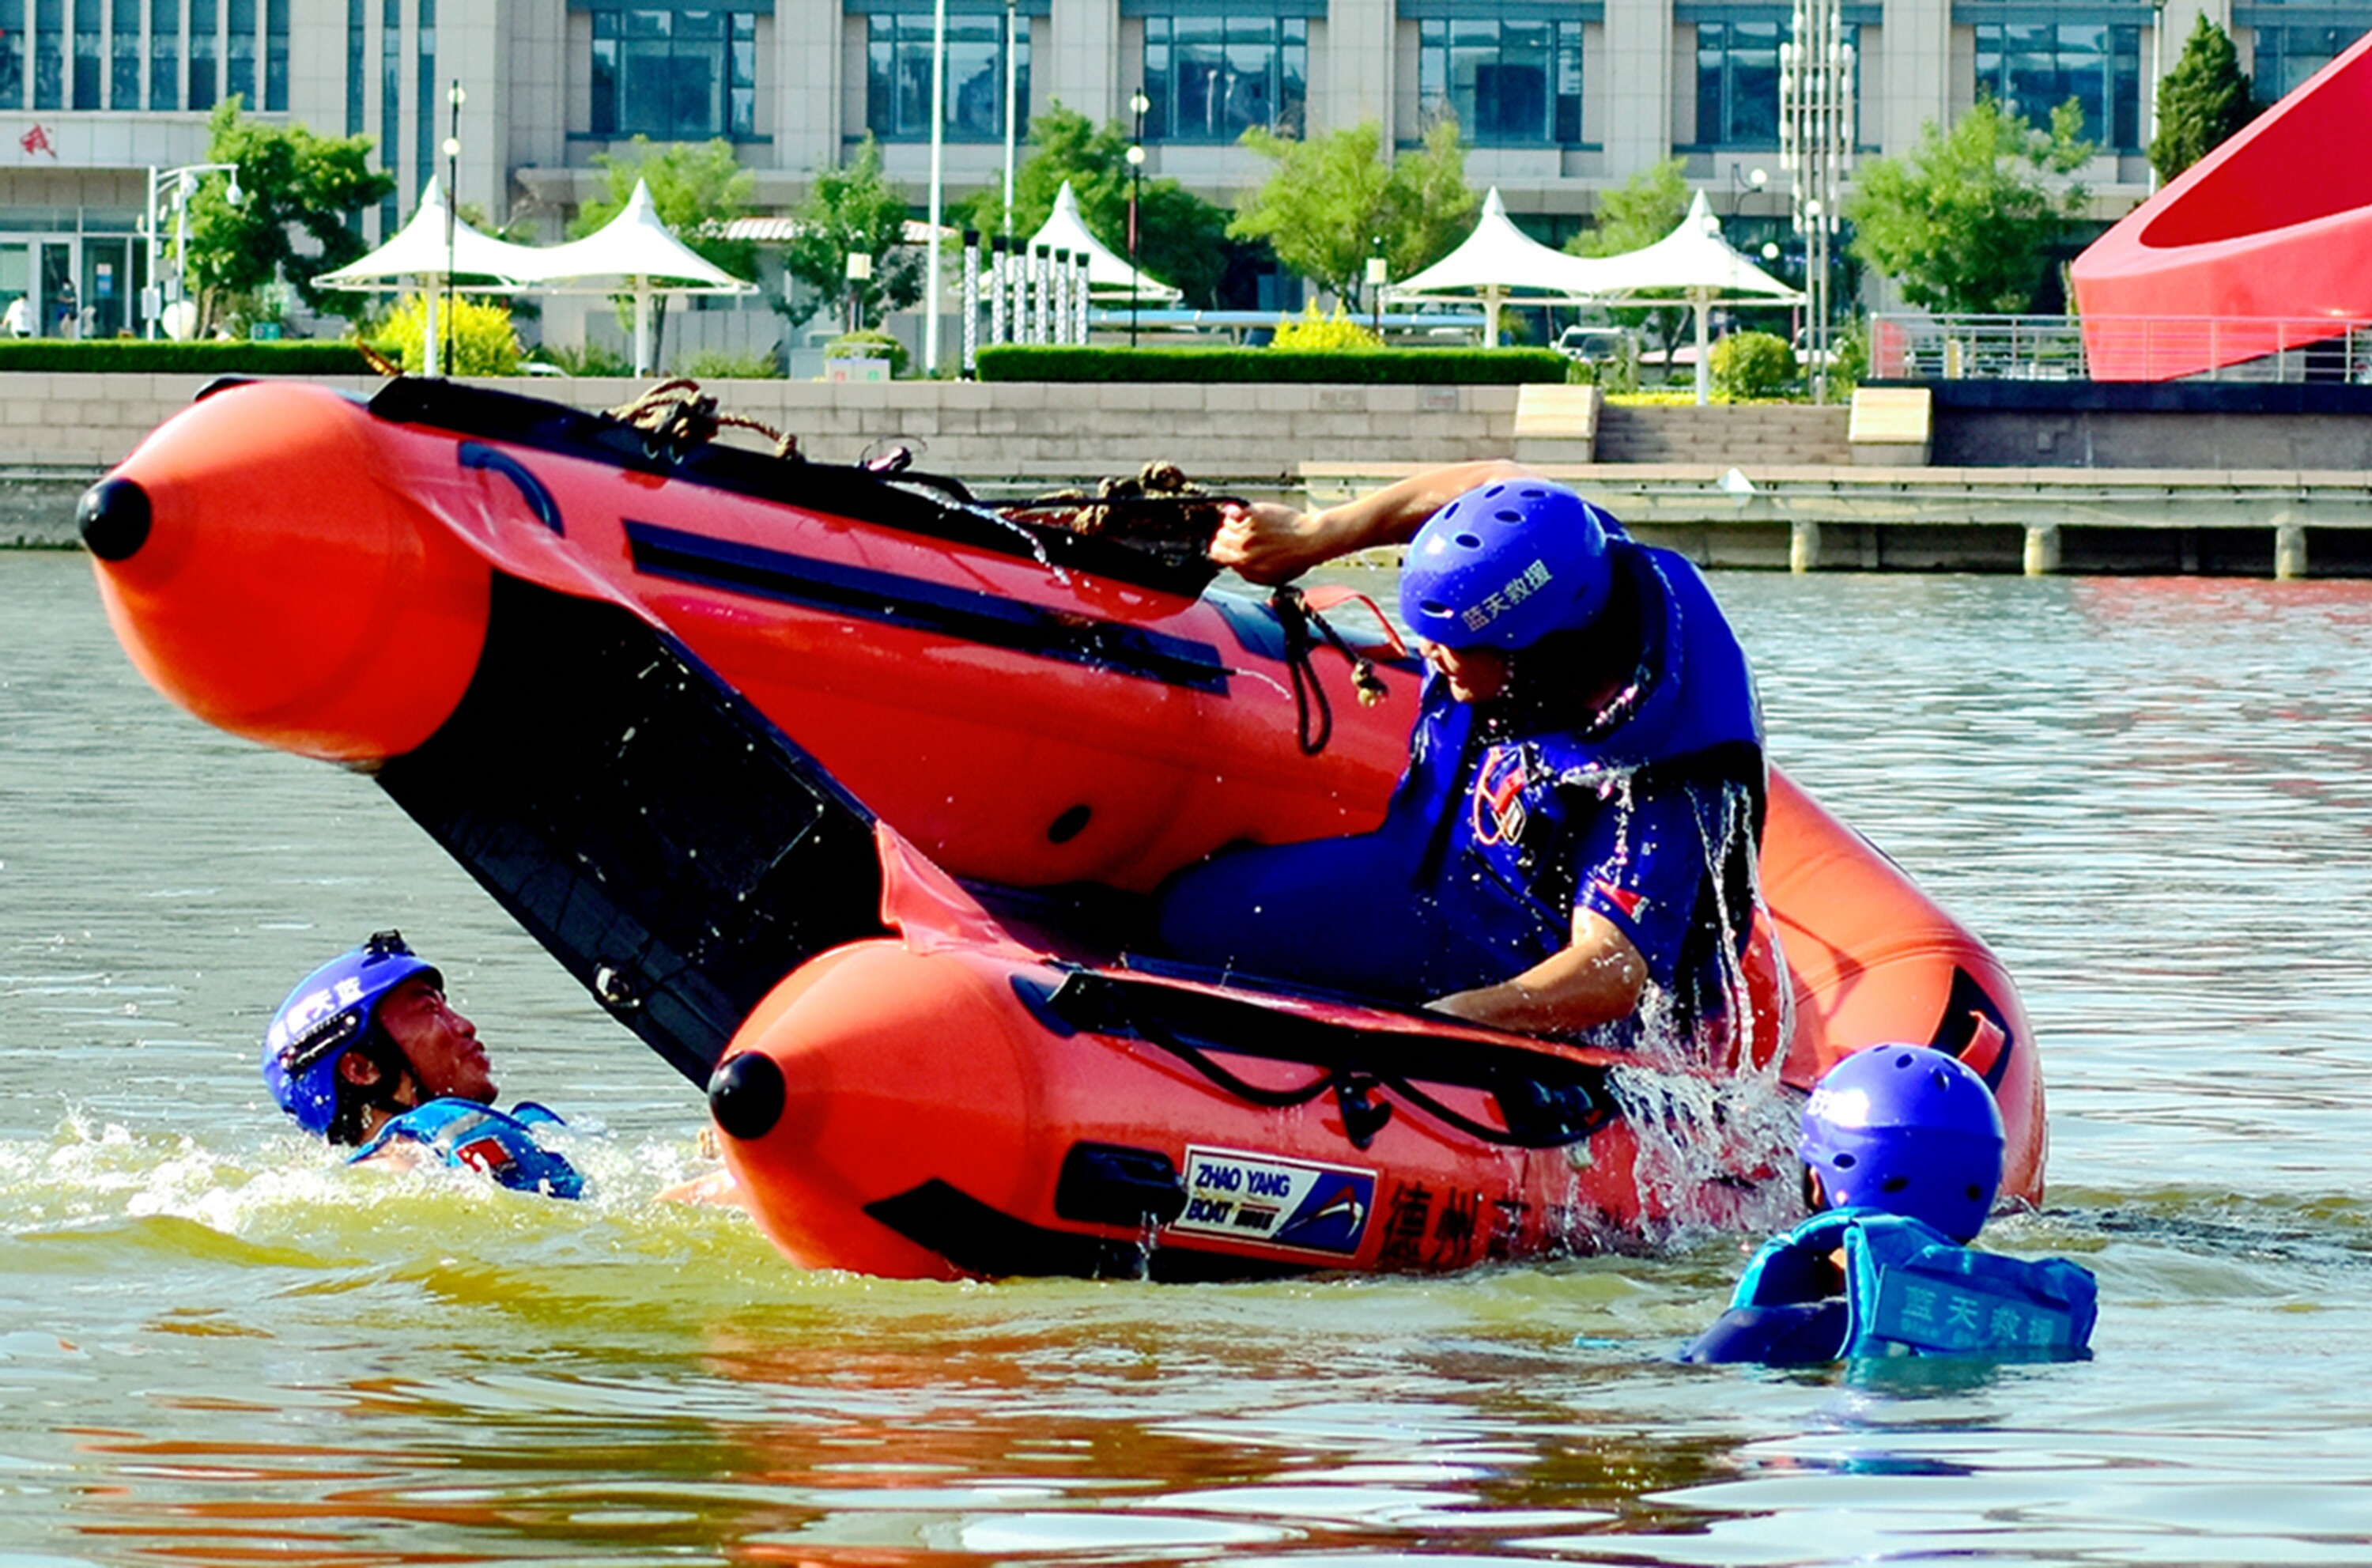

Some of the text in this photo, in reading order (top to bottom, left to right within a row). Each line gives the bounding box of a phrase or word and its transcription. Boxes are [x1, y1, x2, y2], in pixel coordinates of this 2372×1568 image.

[1461, 558, 1553, 632] 蓝天救援
[1195, 1164, 1290, 1198] ZHAO YANG
[1186, 1197, 1233, 1223] BOAT
